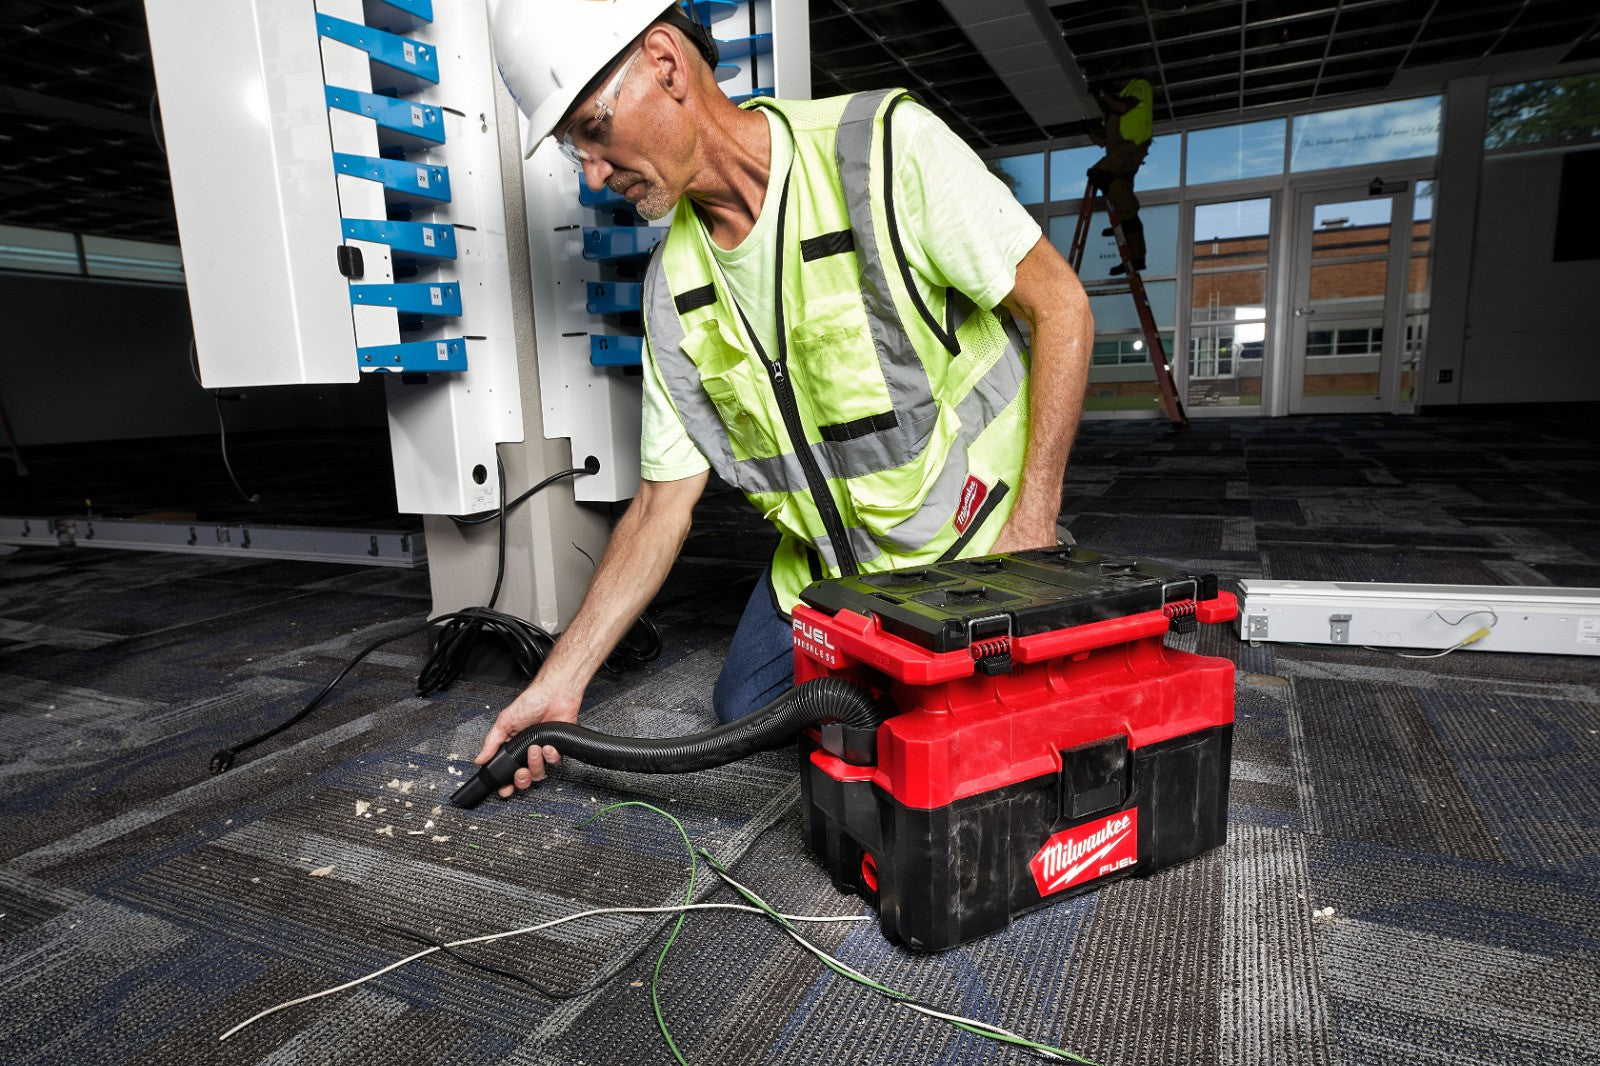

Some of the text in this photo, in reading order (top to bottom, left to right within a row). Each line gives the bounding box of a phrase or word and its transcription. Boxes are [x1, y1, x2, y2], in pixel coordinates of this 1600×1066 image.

[793, 618, 835, 650] FUEL
[1038, 815, 1131, 882] Milwaukee
[1099, 857, 1138, 876] FUEL
